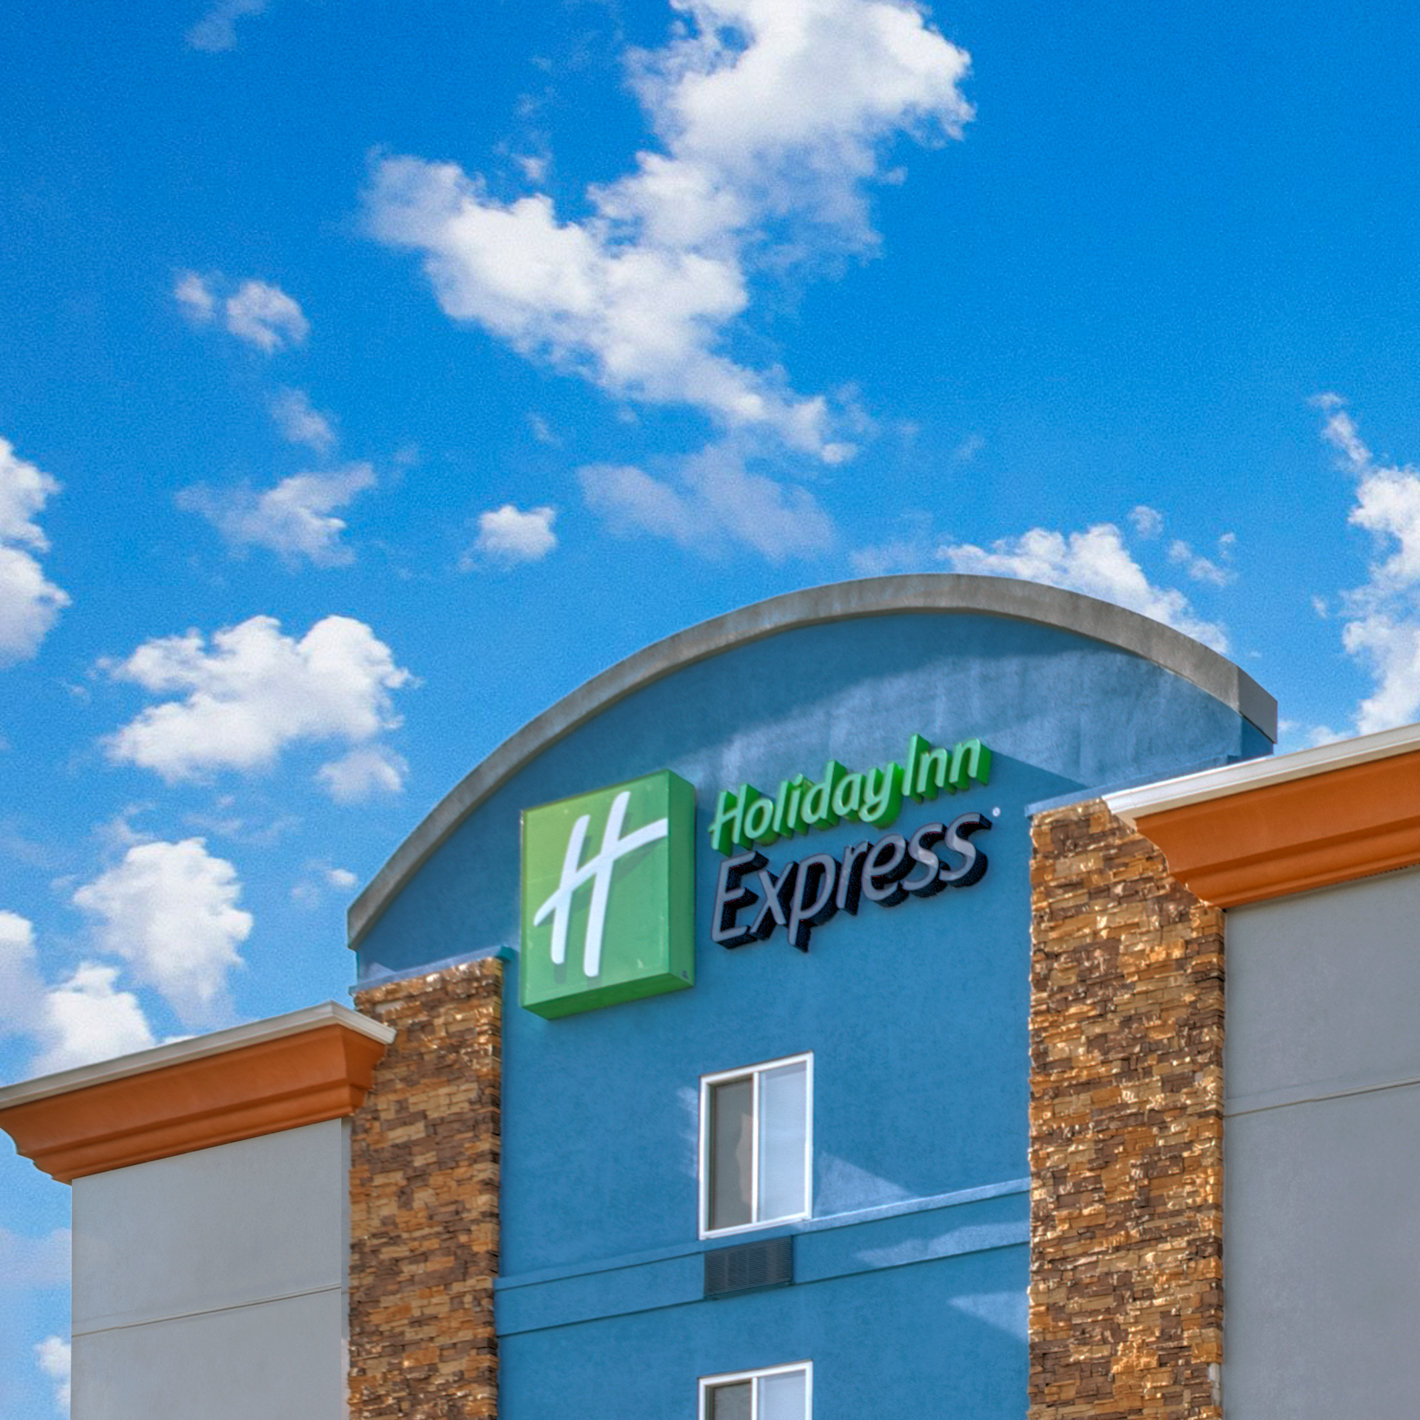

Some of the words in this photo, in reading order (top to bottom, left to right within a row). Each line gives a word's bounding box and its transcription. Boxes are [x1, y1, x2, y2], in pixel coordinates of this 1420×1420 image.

[709, 759, 902, 856] Holiday
[901, 733, 991, 804] Inn
[710, 812, 991, 952] Express
